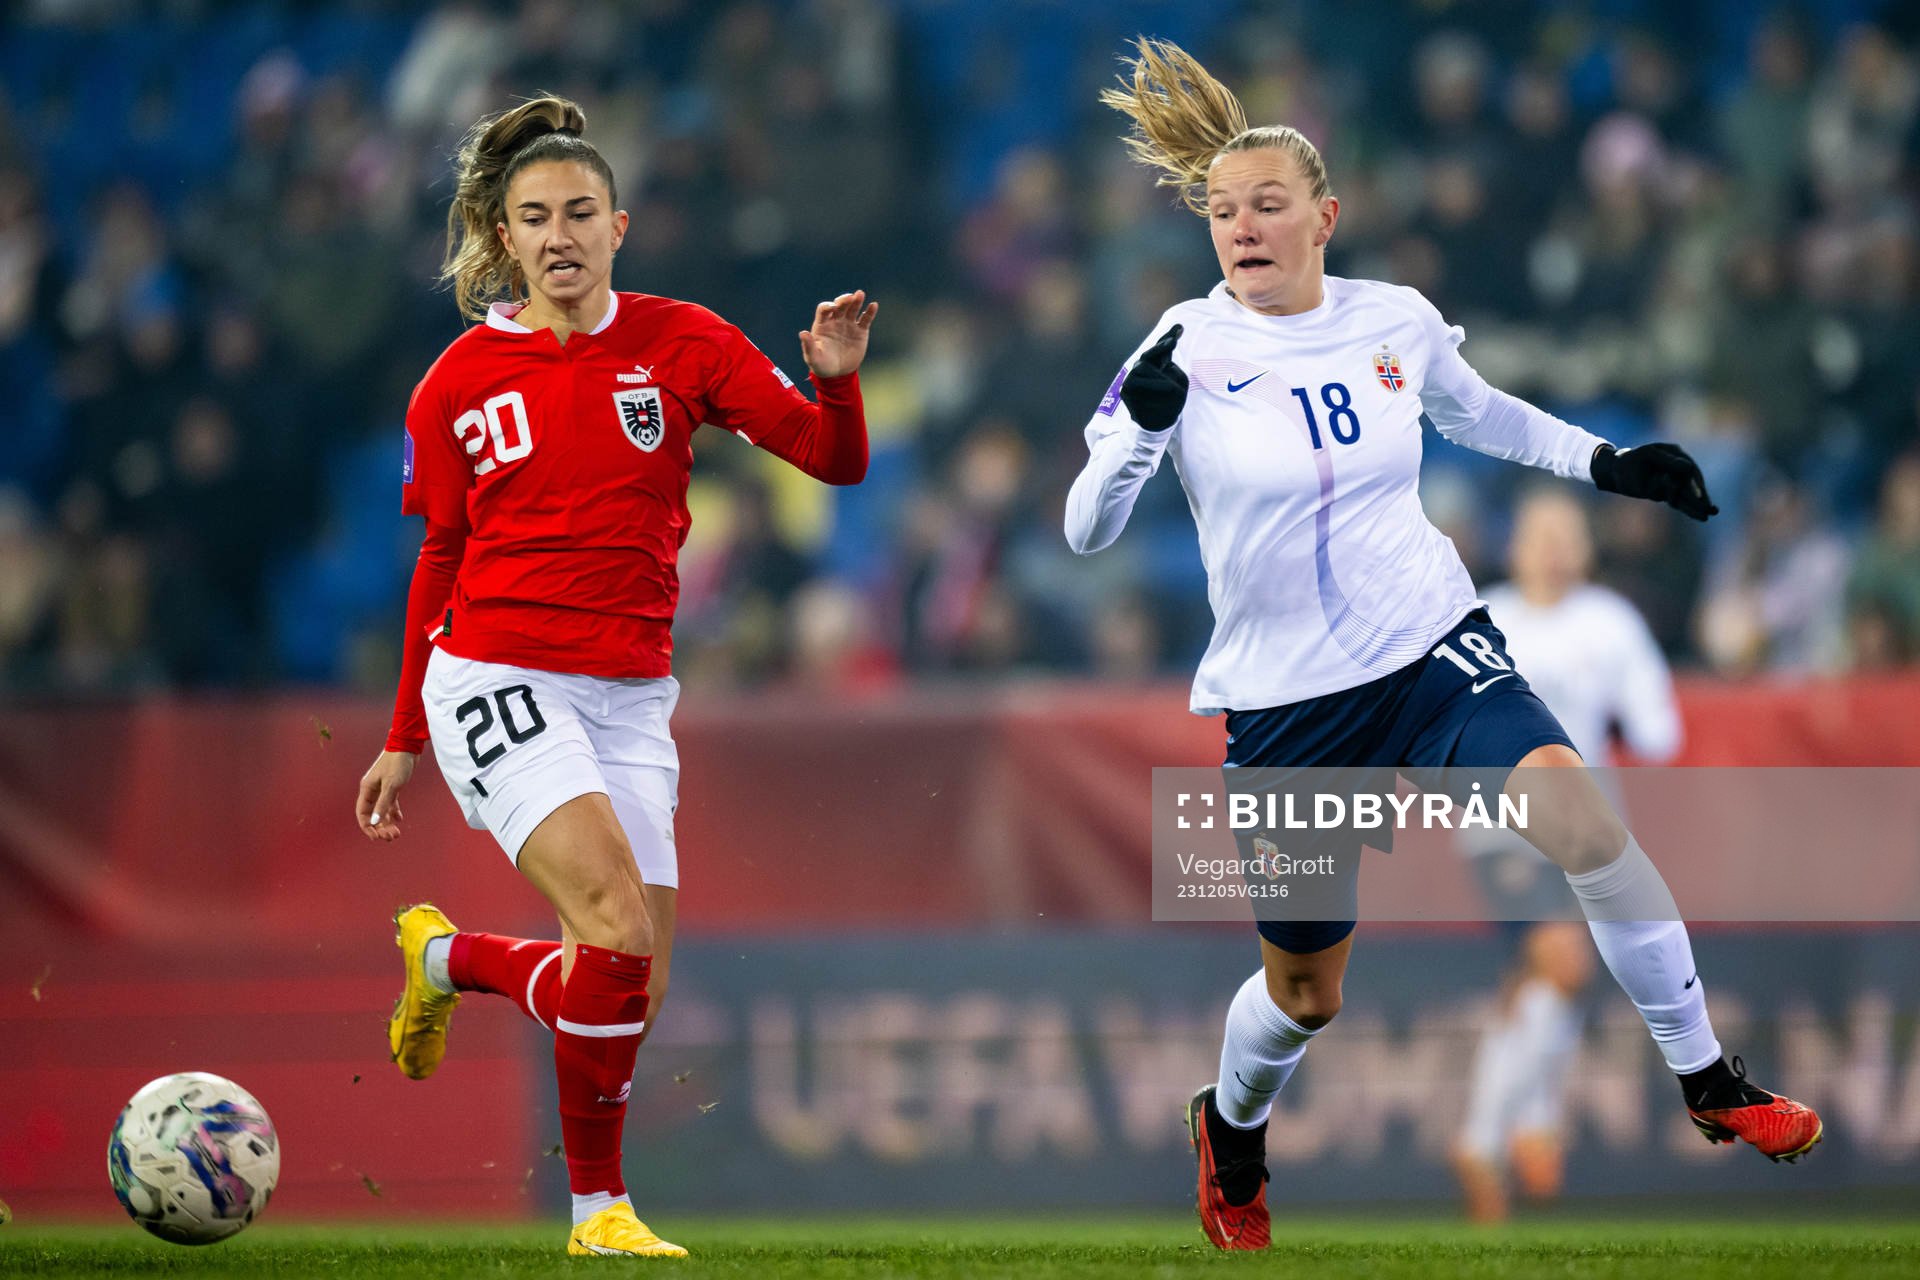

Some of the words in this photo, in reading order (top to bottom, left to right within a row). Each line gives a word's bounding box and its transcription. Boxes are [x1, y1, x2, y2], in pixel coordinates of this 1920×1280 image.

[453, 390, 534, 476] 20
[1290, 382, 1361, 450] 18
[1431, 632, 1512, 678] 18
[455, 684, 548, 769] 20
